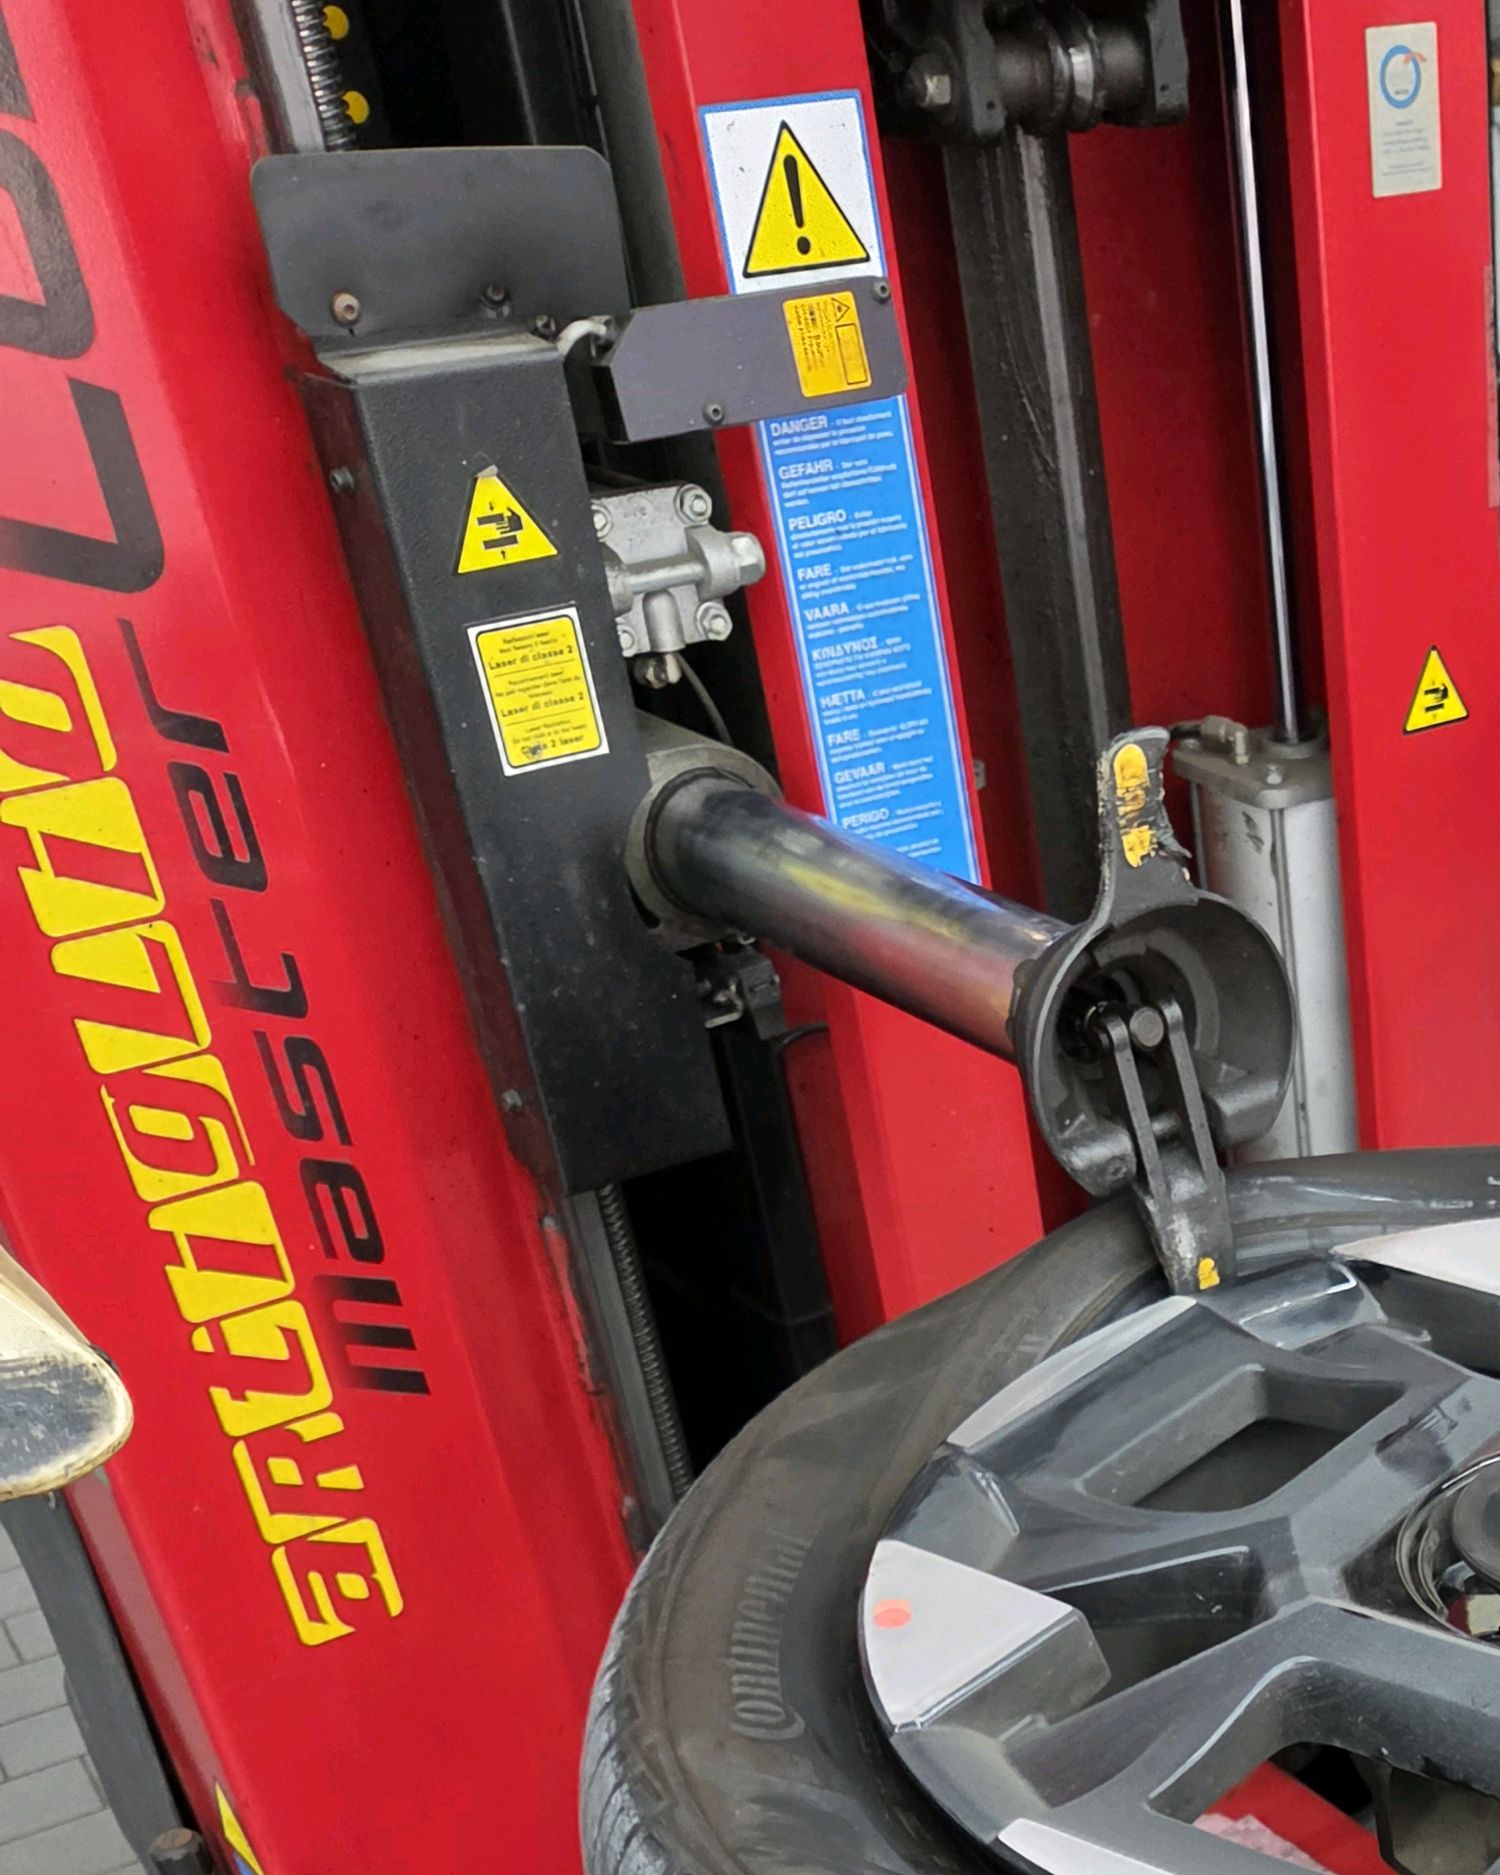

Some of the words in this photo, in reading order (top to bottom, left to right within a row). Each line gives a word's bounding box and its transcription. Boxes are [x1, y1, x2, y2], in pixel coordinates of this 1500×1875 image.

[770, 416, 828, 437] DANGER
[778, 459, 834, 480] GEFAHR
[788, 509, 847, 531] PELIGRO
[797, 564, 832, 581] FARE
[804, 602, 850, 622] VAARA
[827, 729, 861, 747] FARE
[834, 762, 886, 784] GEVAAR
[842, 808, 890, 829] PERIGO
